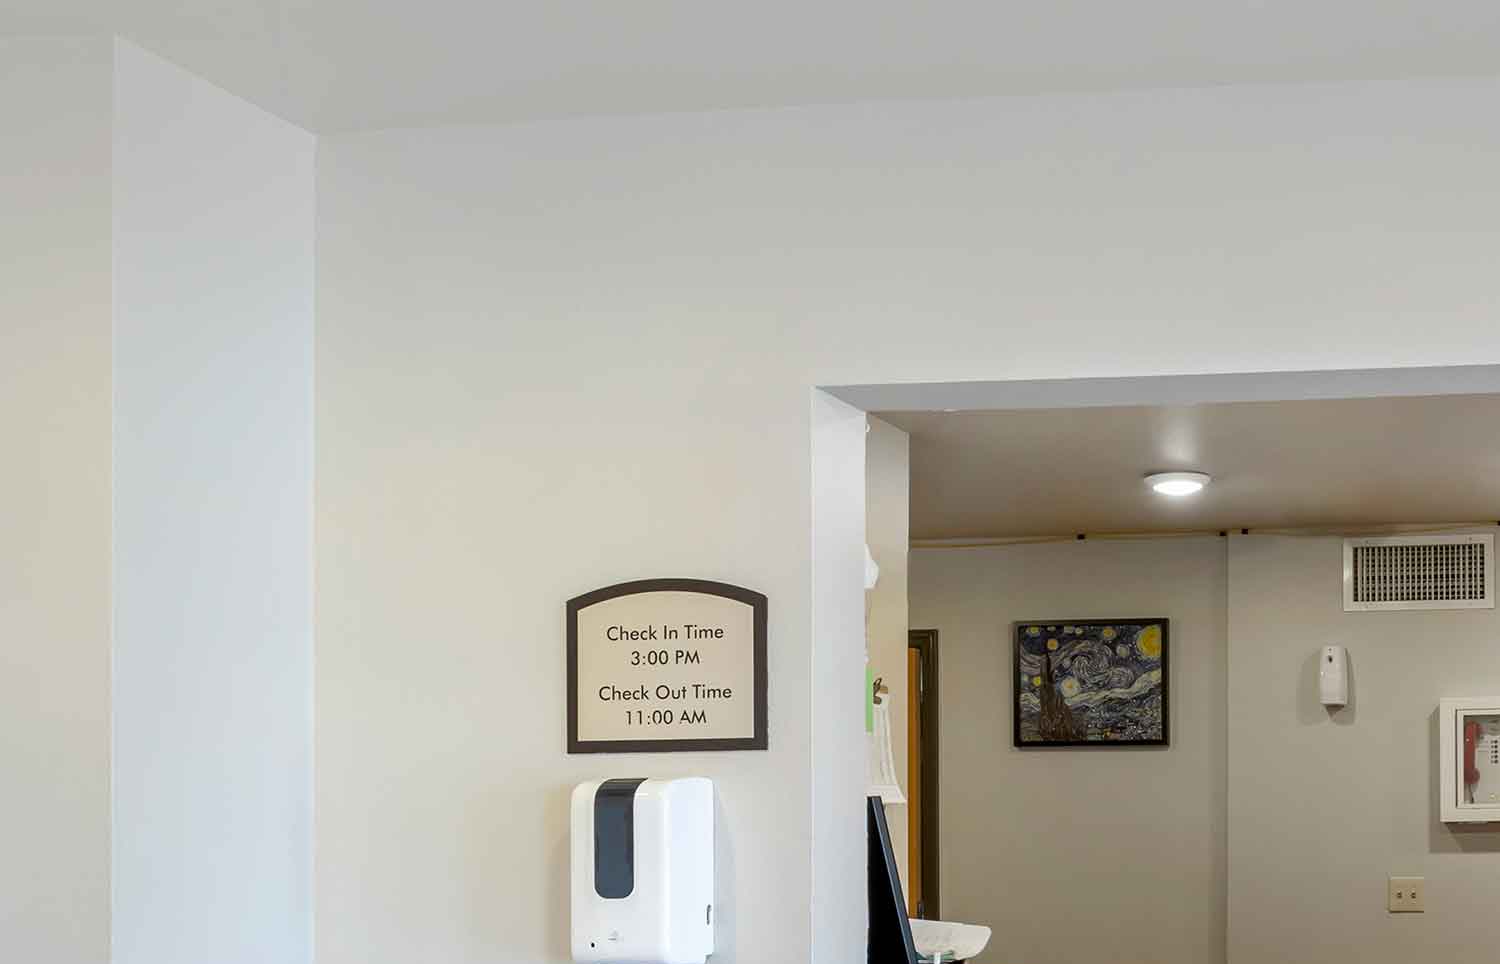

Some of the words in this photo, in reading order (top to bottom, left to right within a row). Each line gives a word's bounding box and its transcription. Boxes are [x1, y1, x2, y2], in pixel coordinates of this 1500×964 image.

[606, 625, 658, 641] Check
[663, 625, 678, 640] In
[684, 624, 724, 640] Time
[630, 650, 669, 666] 3:00
[675, 650, 700, 665] PM
[599, 685, 649, 701] Check
[655, 684, 687, 700] Out
[692, 684, 732, 699] Time
[626, 710, 673, 725] 11:00
[679, 710, 707, 724] AM
